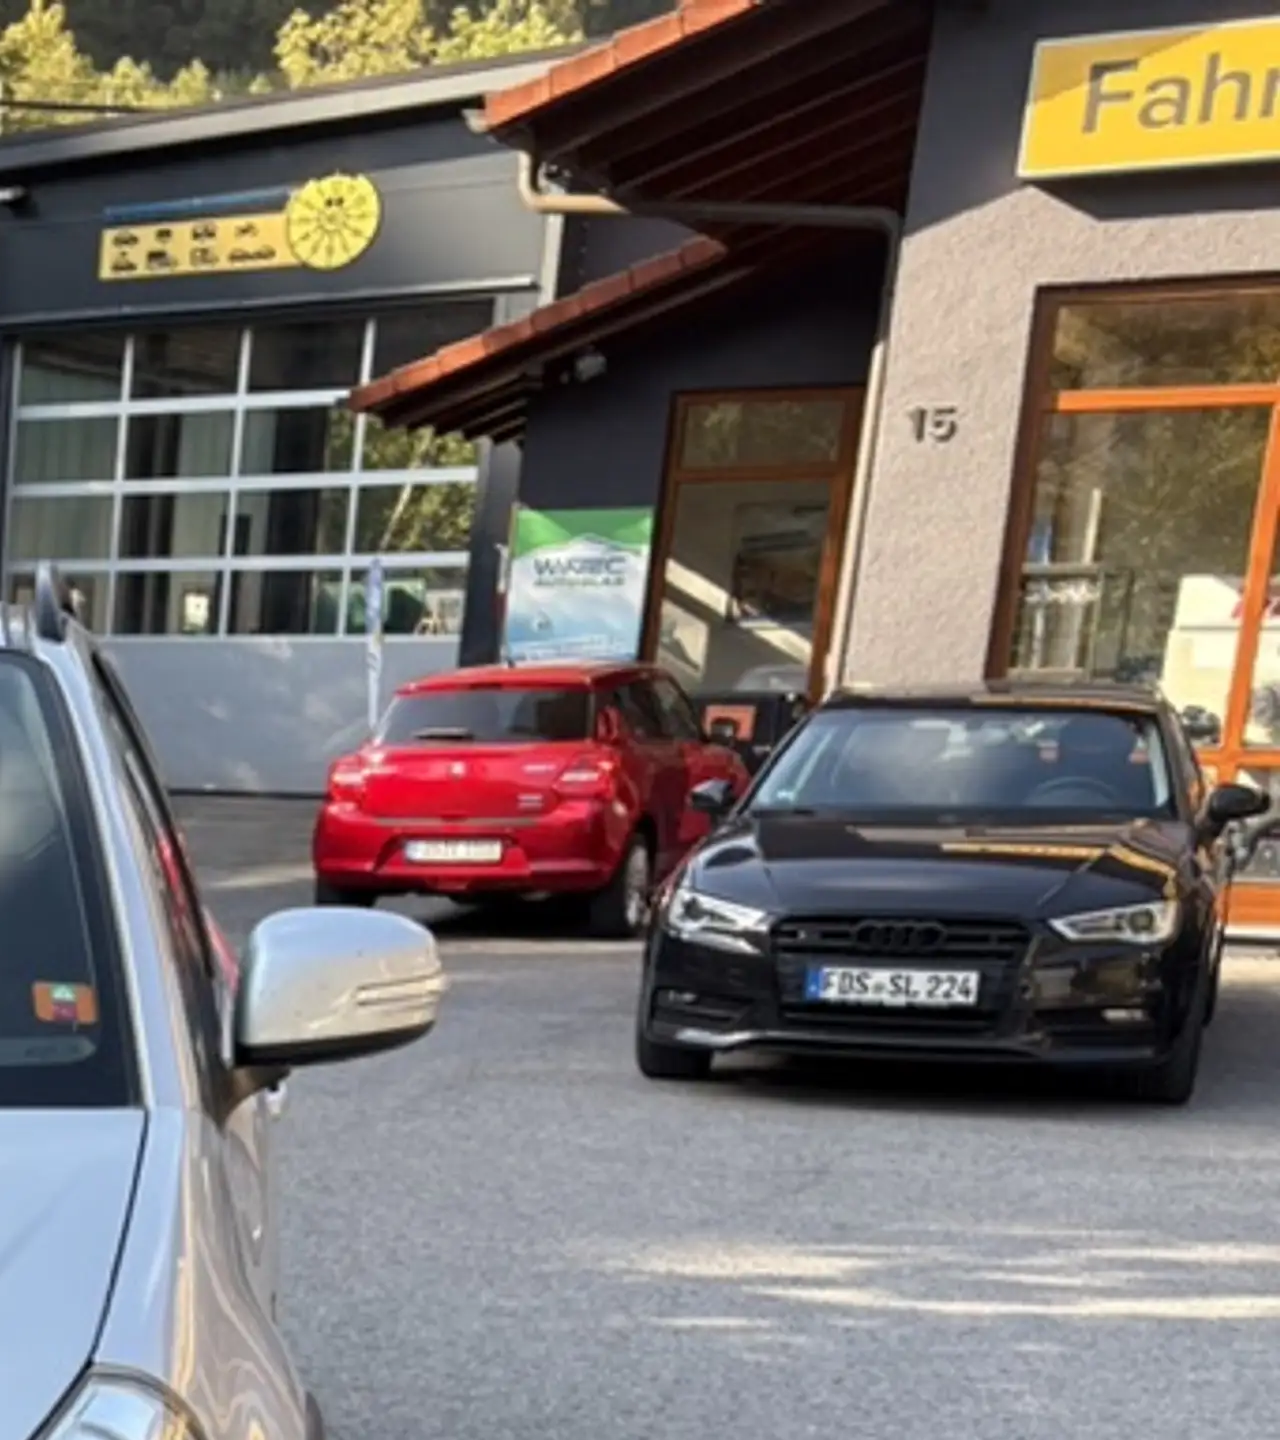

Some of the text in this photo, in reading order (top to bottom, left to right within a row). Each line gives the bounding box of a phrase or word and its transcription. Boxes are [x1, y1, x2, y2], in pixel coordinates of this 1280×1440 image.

[1081, 53, 1280, 134] Fahr
[908, 407, 957, 443] 15
[823, 970, 972, 1001] FDS SL 224
